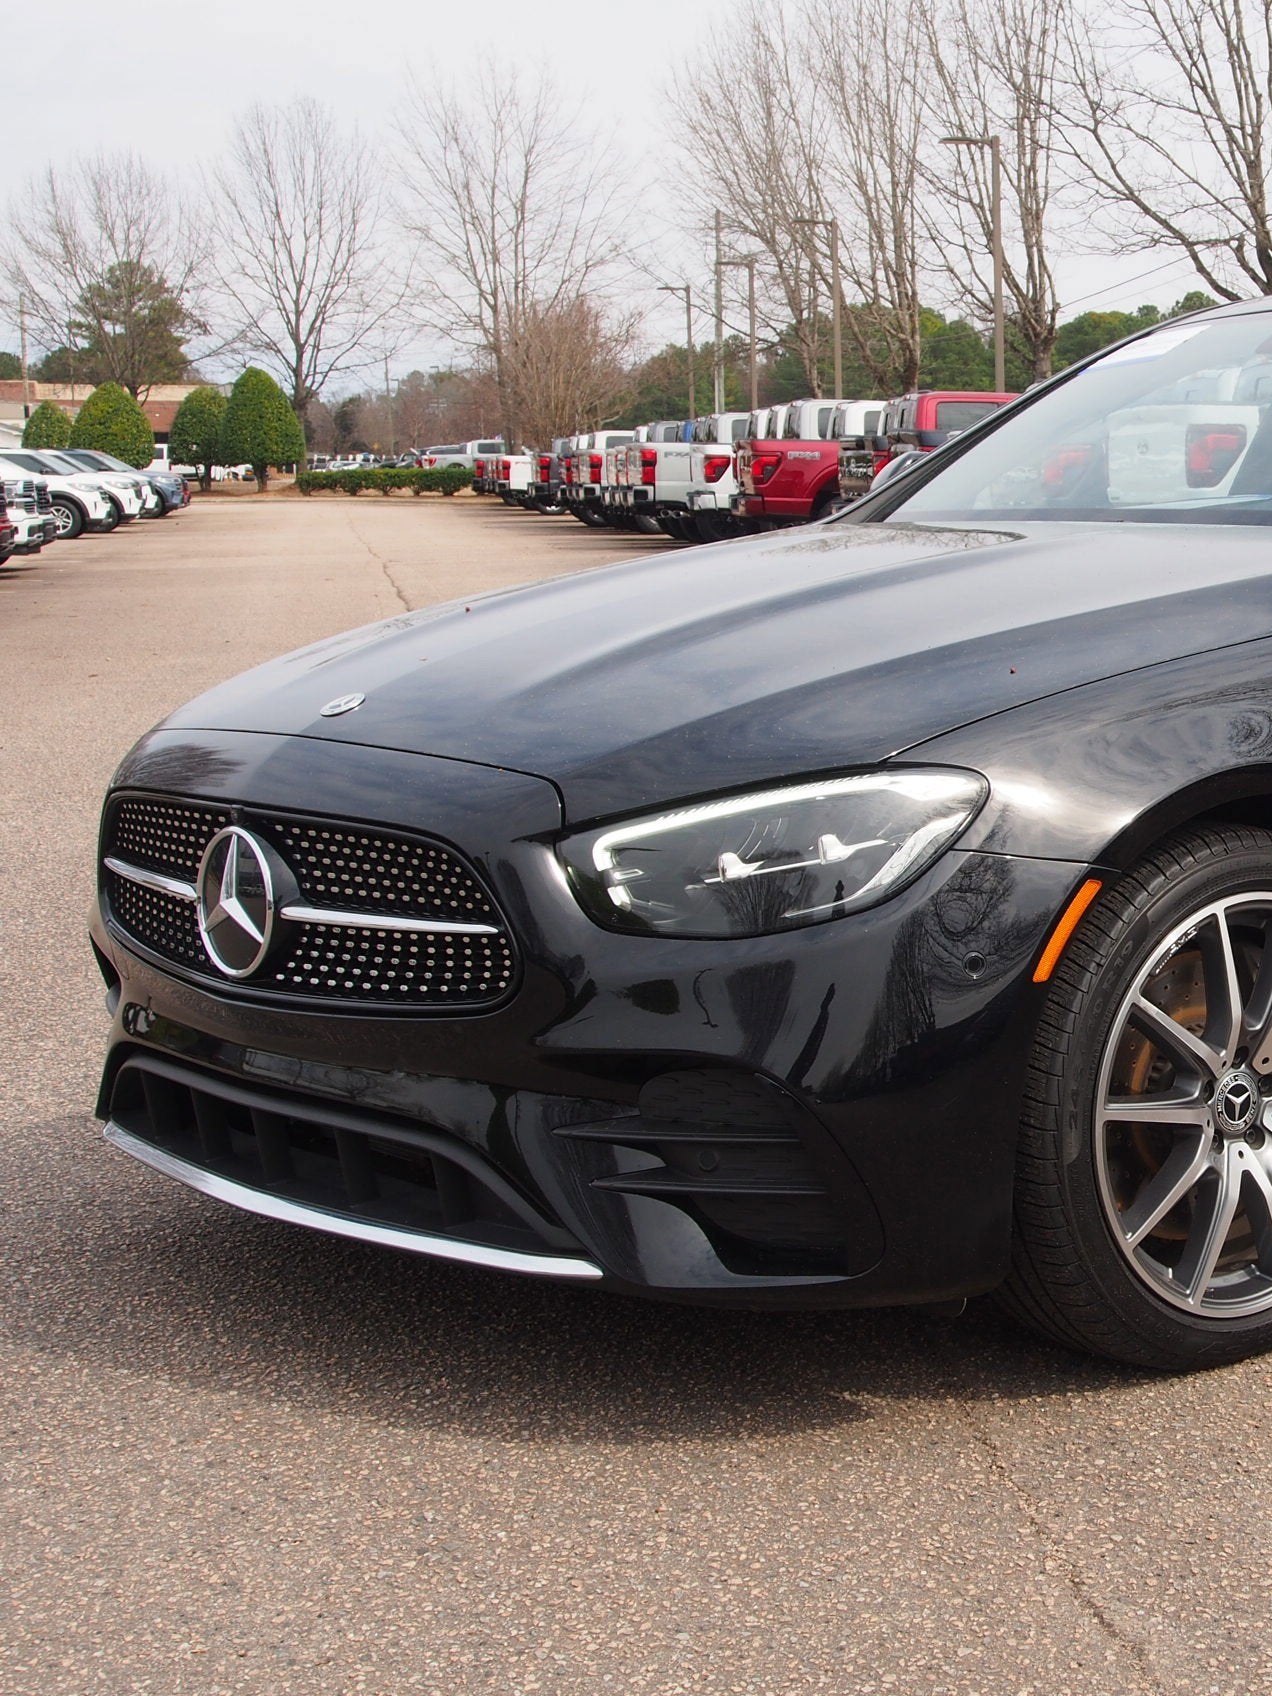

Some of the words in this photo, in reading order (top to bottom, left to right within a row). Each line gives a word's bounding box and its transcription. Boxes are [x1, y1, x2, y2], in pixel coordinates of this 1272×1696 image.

[789, 450, 821, 461] FX4
[1217, 1075, 1236, 1112] MERCEDES
[1245, 1103, 1257, 1123] BENZ
